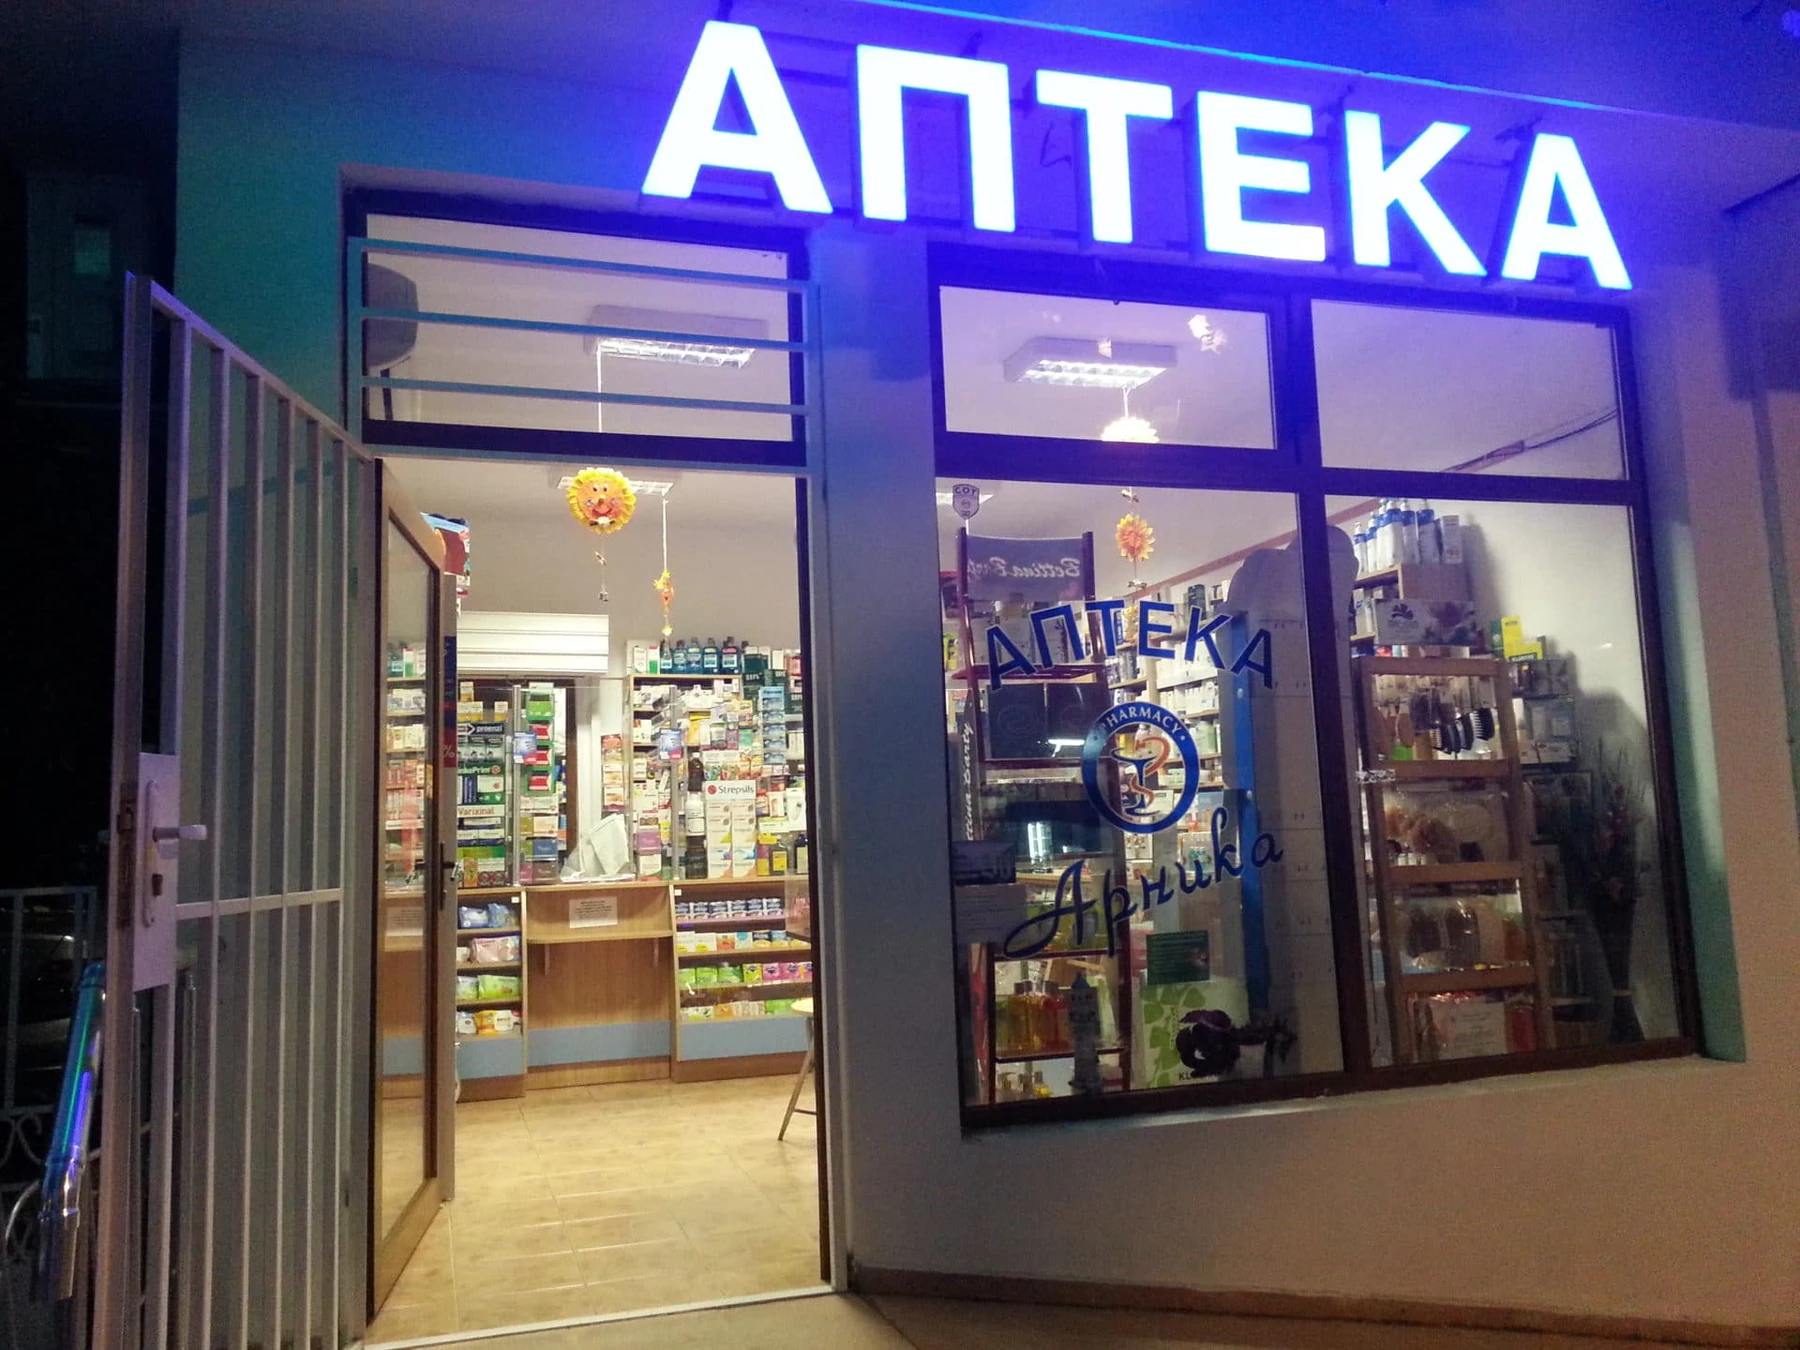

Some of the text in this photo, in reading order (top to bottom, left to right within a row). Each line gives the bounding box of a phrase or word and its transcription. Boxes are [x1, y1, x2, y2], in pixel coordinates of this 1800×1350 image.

[641, 20, 1633, 290] АПТЕКА
[985, 600, 1273, 692] АПТЕКА
[1102, 704, 1183, 734] PHARMACY
[718, 785, 754, 795] Strepsils
[1002, 806, 1284, 958] Арника
